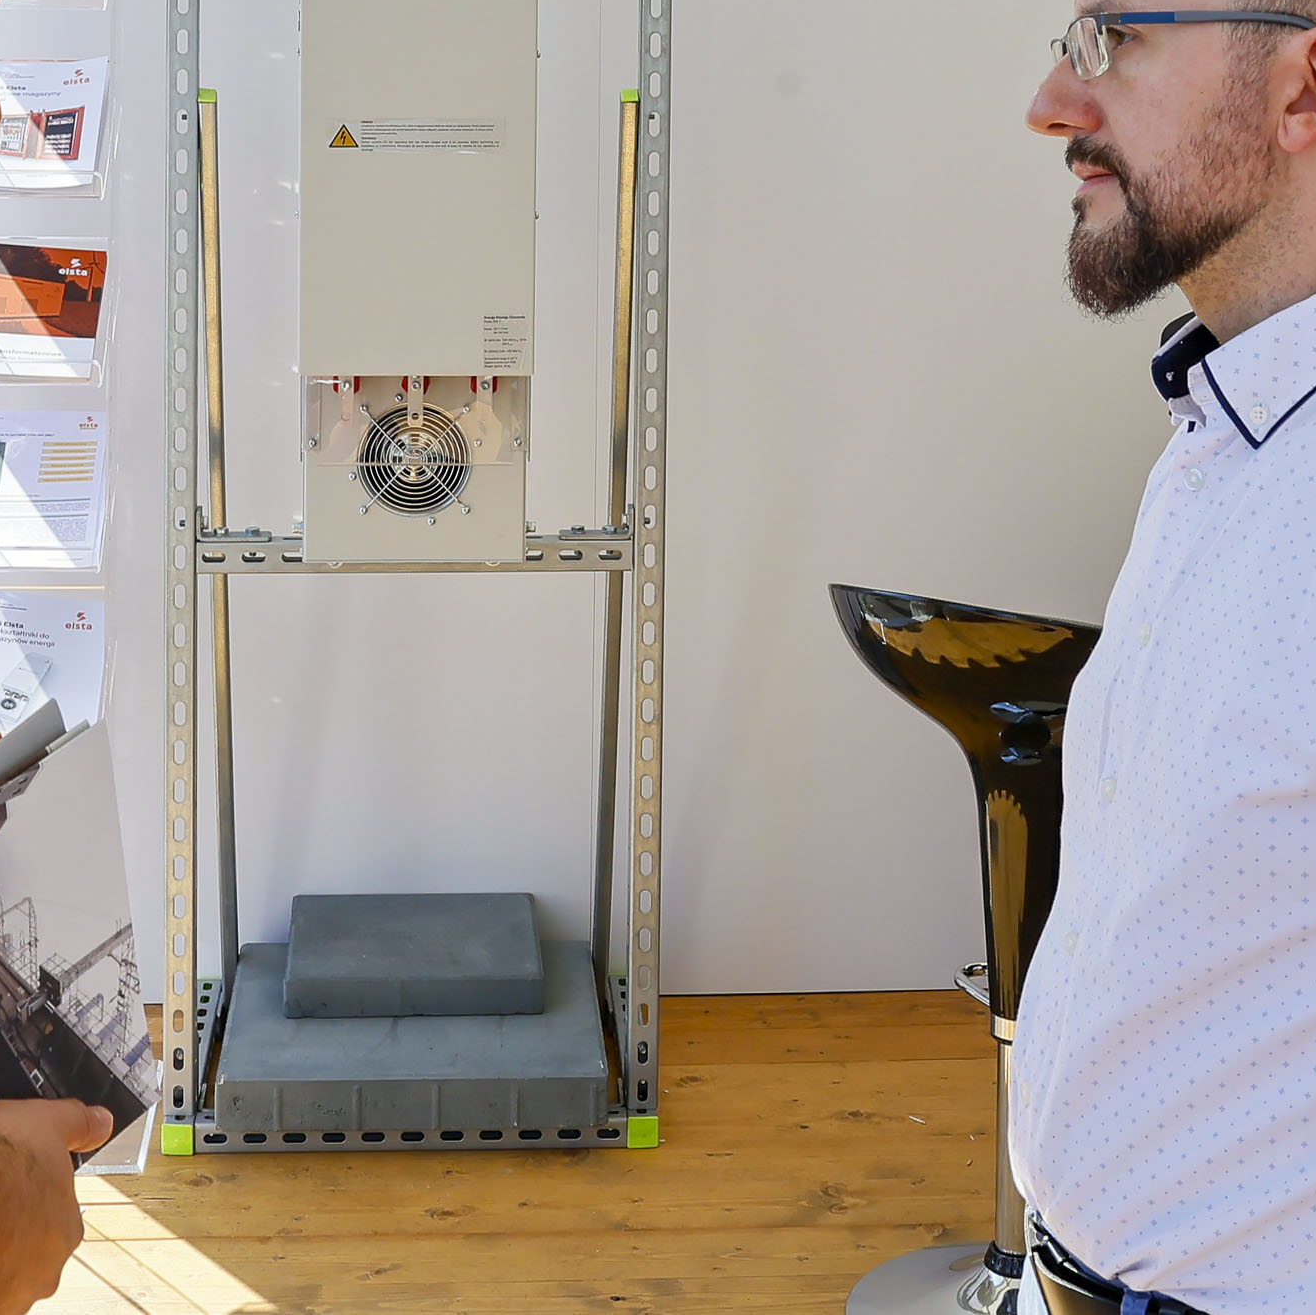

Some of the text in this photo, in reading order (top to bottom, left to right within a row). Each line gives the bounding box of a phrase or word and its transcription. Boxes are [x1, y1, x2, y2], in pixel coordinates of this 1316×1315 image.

[63, 77, 90, 86] elsta
[58, 268, 88, 277] elsta
[65, 621, 93, 630] elsta
